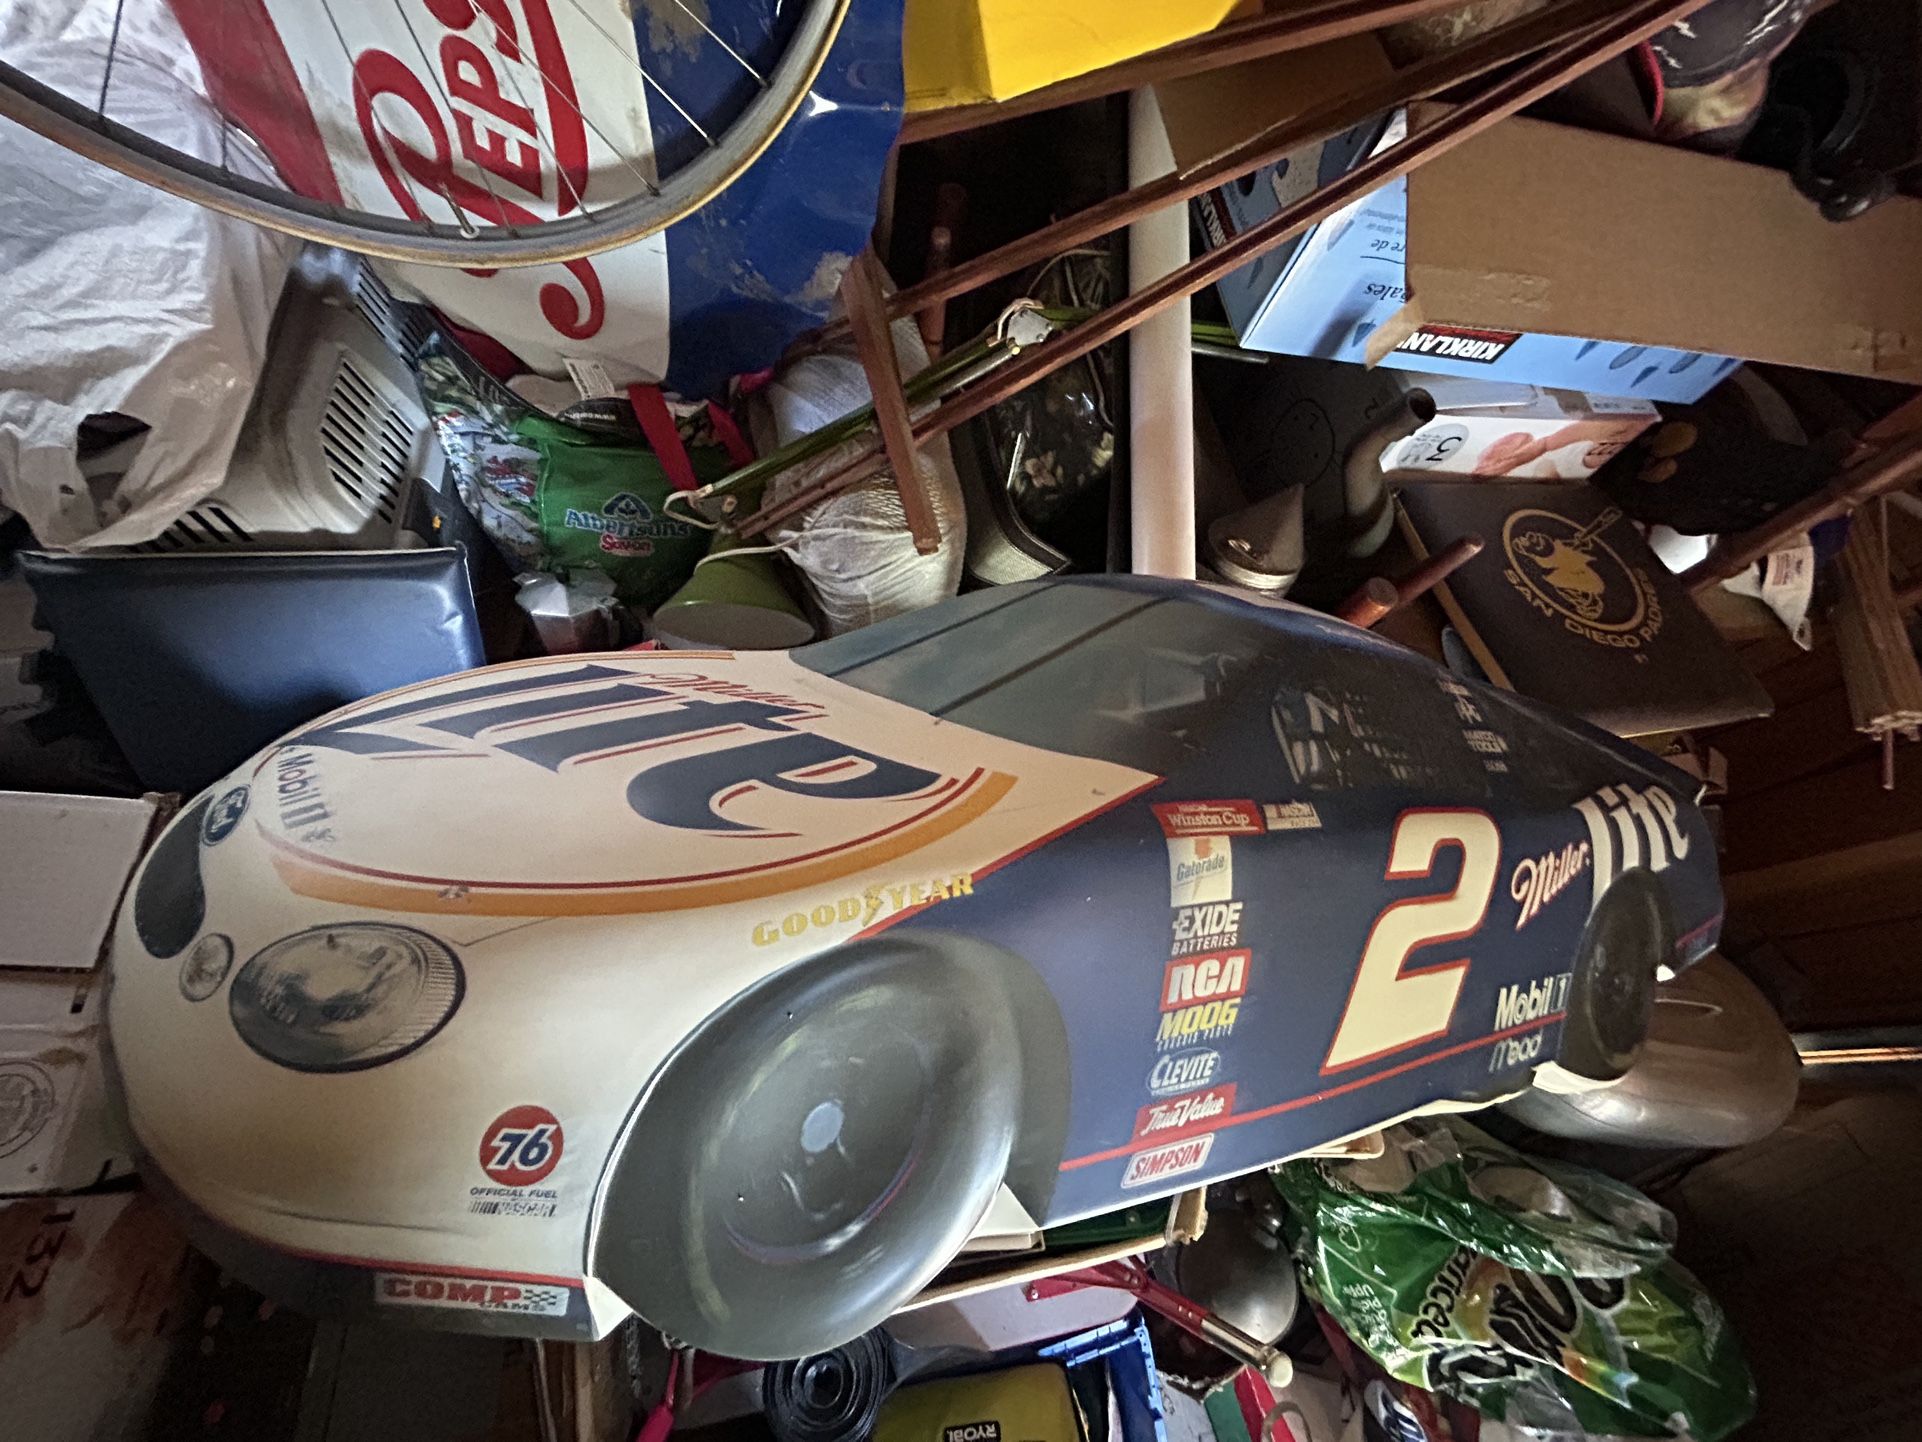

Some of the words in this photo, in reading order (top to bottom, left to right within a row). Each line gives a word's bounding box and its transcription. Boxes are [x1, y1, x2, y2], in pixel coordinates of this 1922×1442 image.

[1396, 331, 1506, 362] KIRKLAN
[1425, 435, 1464, 463] 3
[564, 507, 693, 540] Albertsons
[1504, 568, 1554, 618] SAN
[1564, 617, 1641, 649] DIEGO
[277, 752, 322, 808] Mobil
[1167, 812, 1223, 828] Winston
[1222, 811, 1250, 827] Cup
[1176, 853, 1226, 883] Gatorade
[1511, 838, 1593, 931] Miller
[1172, 901, 1244, 941] EXIDE
[1170, 932, 1239, 957] BATTERIES
[1319, 806, 1501, 1077] 2
[1167, 955, 1246, 1005] RCA
[1155, 996, 1243, 1043] MOOG
[1494, 976, 1555, 1033] Mobil
[488, 1123, 558, 1171] 76
[1129, 1141, 1206, 1182] SIMPSON
[469, 1186, 525, 1198] OFFICIAL
[528, 1188, 558, 1199] FUEL
[383, 1278, 522, 1305] COMP
